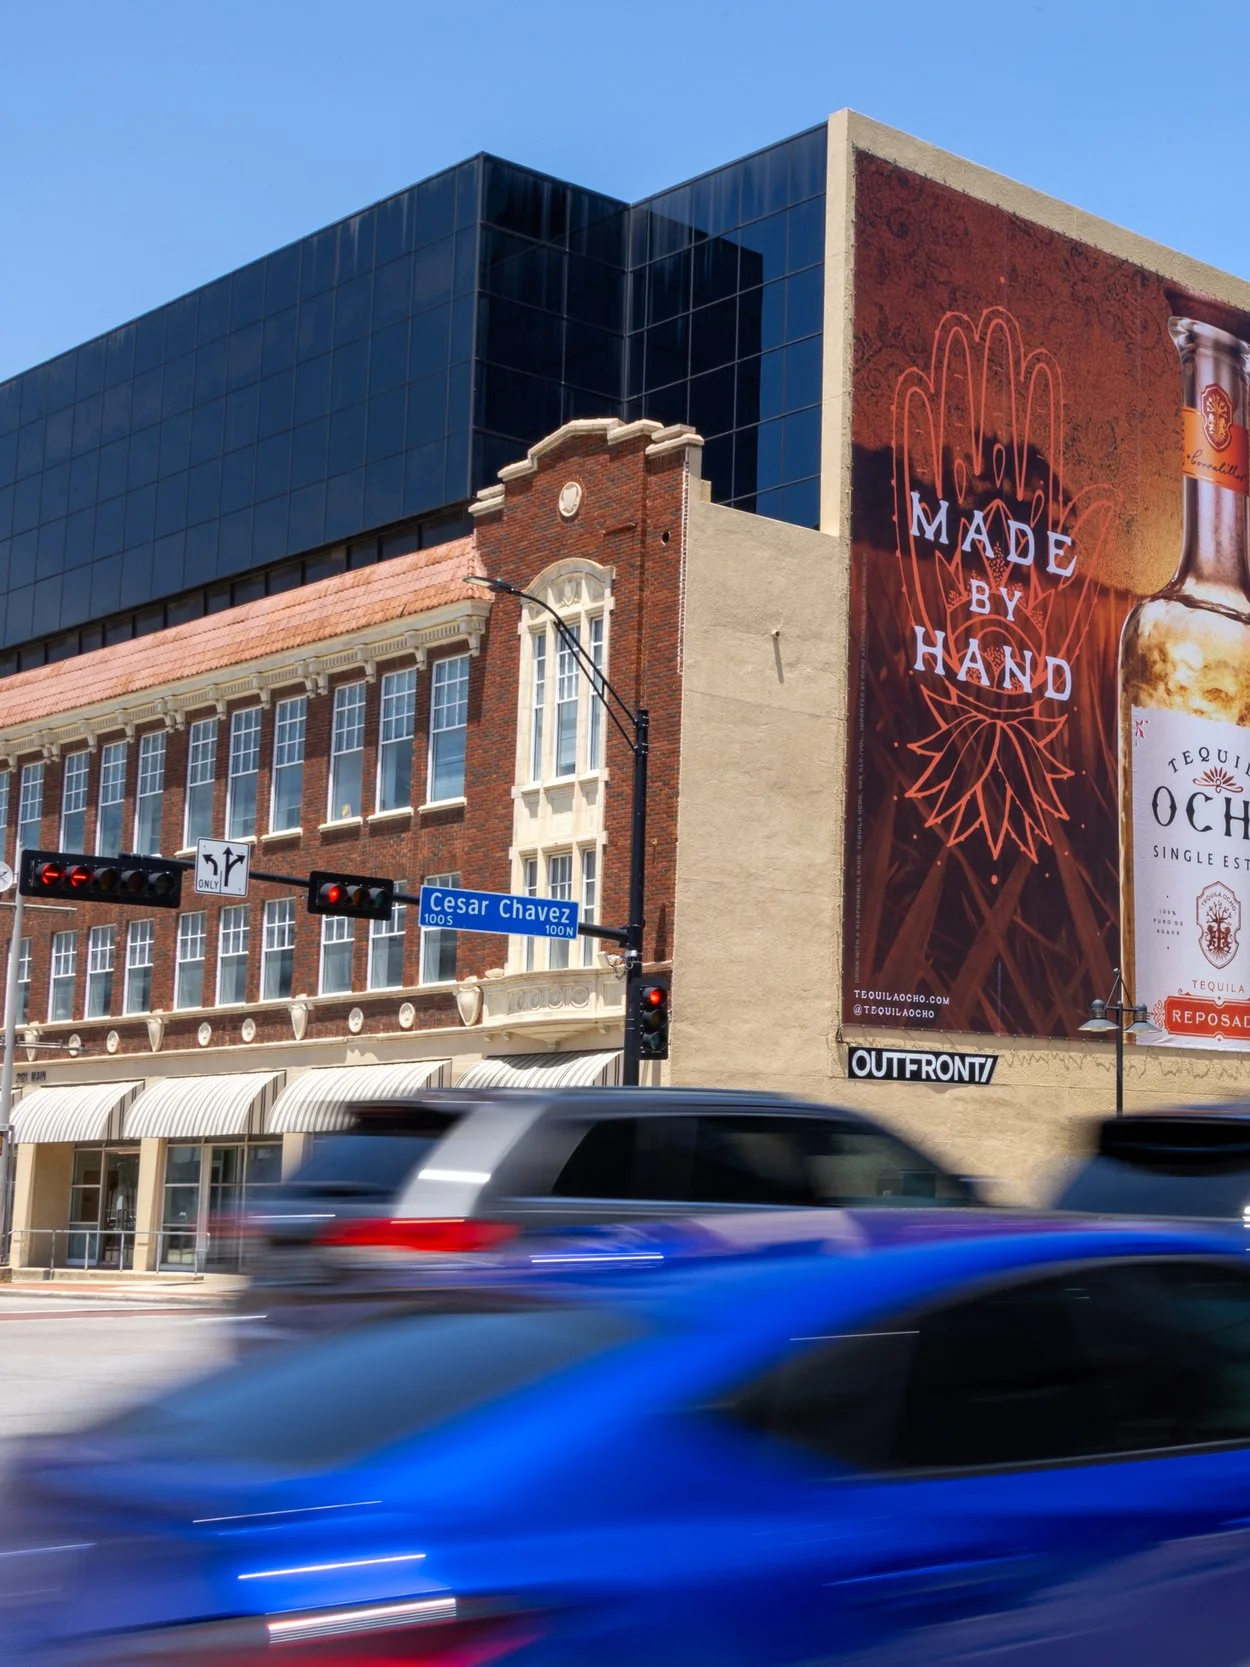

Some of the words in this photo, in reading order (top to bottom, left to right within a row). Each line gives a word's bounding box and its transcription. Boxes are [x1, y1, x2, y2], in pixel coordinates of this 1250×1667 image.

[910, 491, 1077, 577] MADE
[969, 578, 1022, 622] BY
[913, 625, 1072, 701] HAND
[1154, 845, 1214, 866] SINGLE
[199, 879, 219, 889] ONLY
[430, 892, 489, 915] Cesar
[499, 899, 570, 924] Chavez
[853, 989, 950, 1005] TEQUILAOCHO.COM
[1192, 980, 1245, 994] TEQUILA
[853, 1004, 935, 1018] @TEQUILAOCHO
